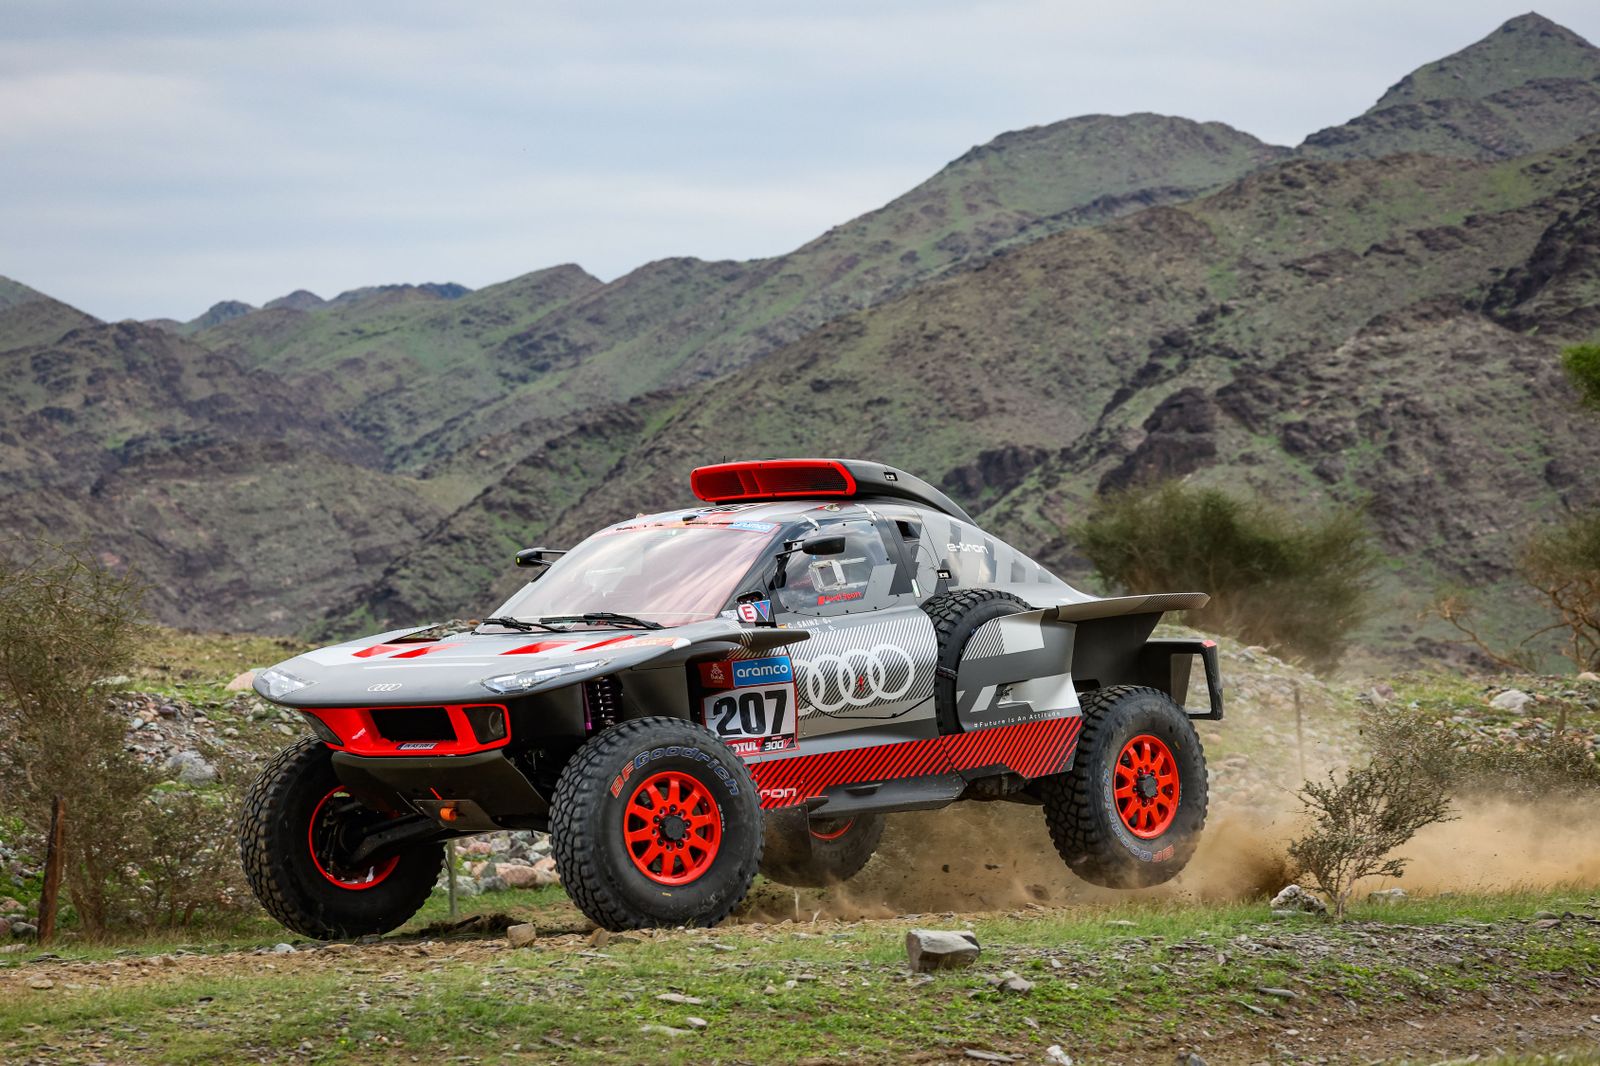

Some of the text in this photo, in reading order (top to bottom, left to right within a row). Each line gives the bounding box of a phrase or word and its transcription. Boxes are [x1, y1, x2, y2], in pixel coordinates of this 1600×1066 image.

[947, 542, 989, 554] e-tron
[741, 606, 754, 620] E
[736, 664, 789, 678] aramco
[713, 689, 787, 736] 207
[974, 719, 1005, 728] #Future
[1029, 711, 1060, 720] Attitude
[765, 738, 792, 751] 300V
[610, 746, 740, 799] BFGoodrich
